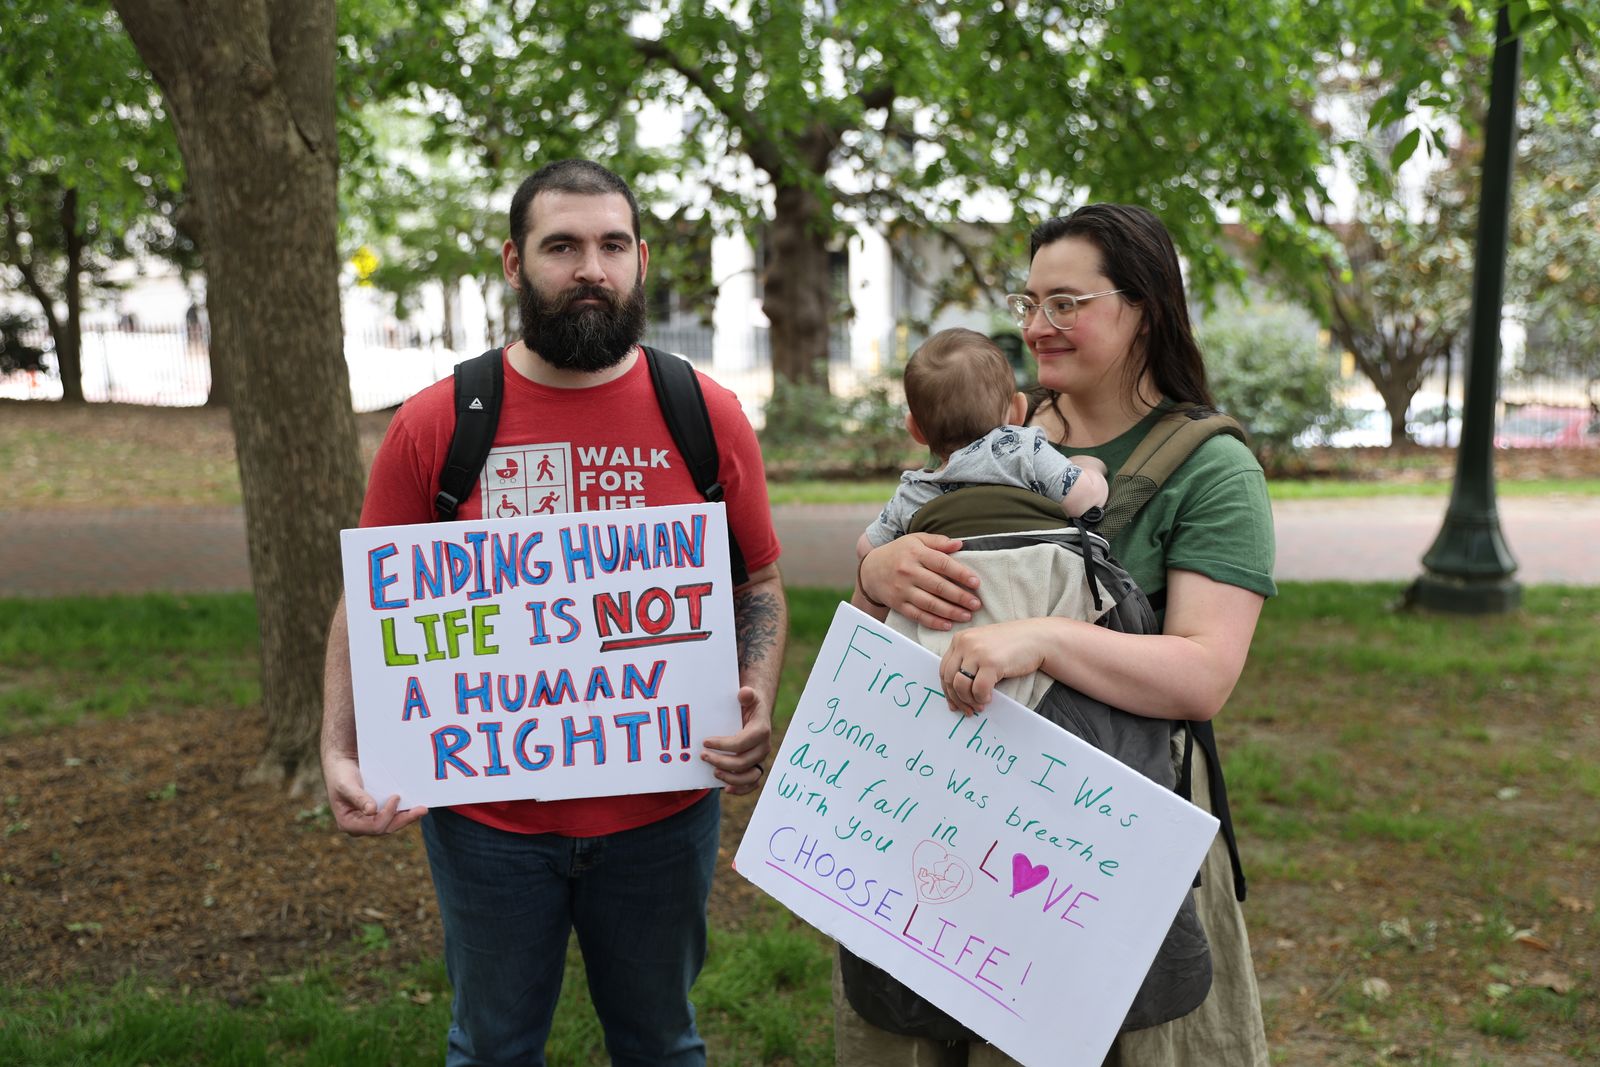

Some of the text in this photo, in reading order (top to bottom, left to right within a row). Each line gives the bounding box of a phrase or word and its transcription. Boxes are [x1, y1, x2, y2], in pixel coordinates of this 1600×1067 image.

[577, 447, 671, 468] WALK
[580, 470, 644, 491] FOR
[368, 514, 707, 609] ENDING HUMAN
[381, 582, 713, 666] LIFE IS NOT
[402, 660, 667, 721] A HUMAN
[430, 704, 691, 780] RIGHT!!
[808, 697, 888, 758] gonna
[905, 749, 934, 776] do
[1030, 752, 1067, 793] I
[834, 815, 894, 853] you
[858, 779, 919, 823] fall
[931, 816, 958, 847] in
[768, 826, 1033, 1001] CHOOSE LIFE!
